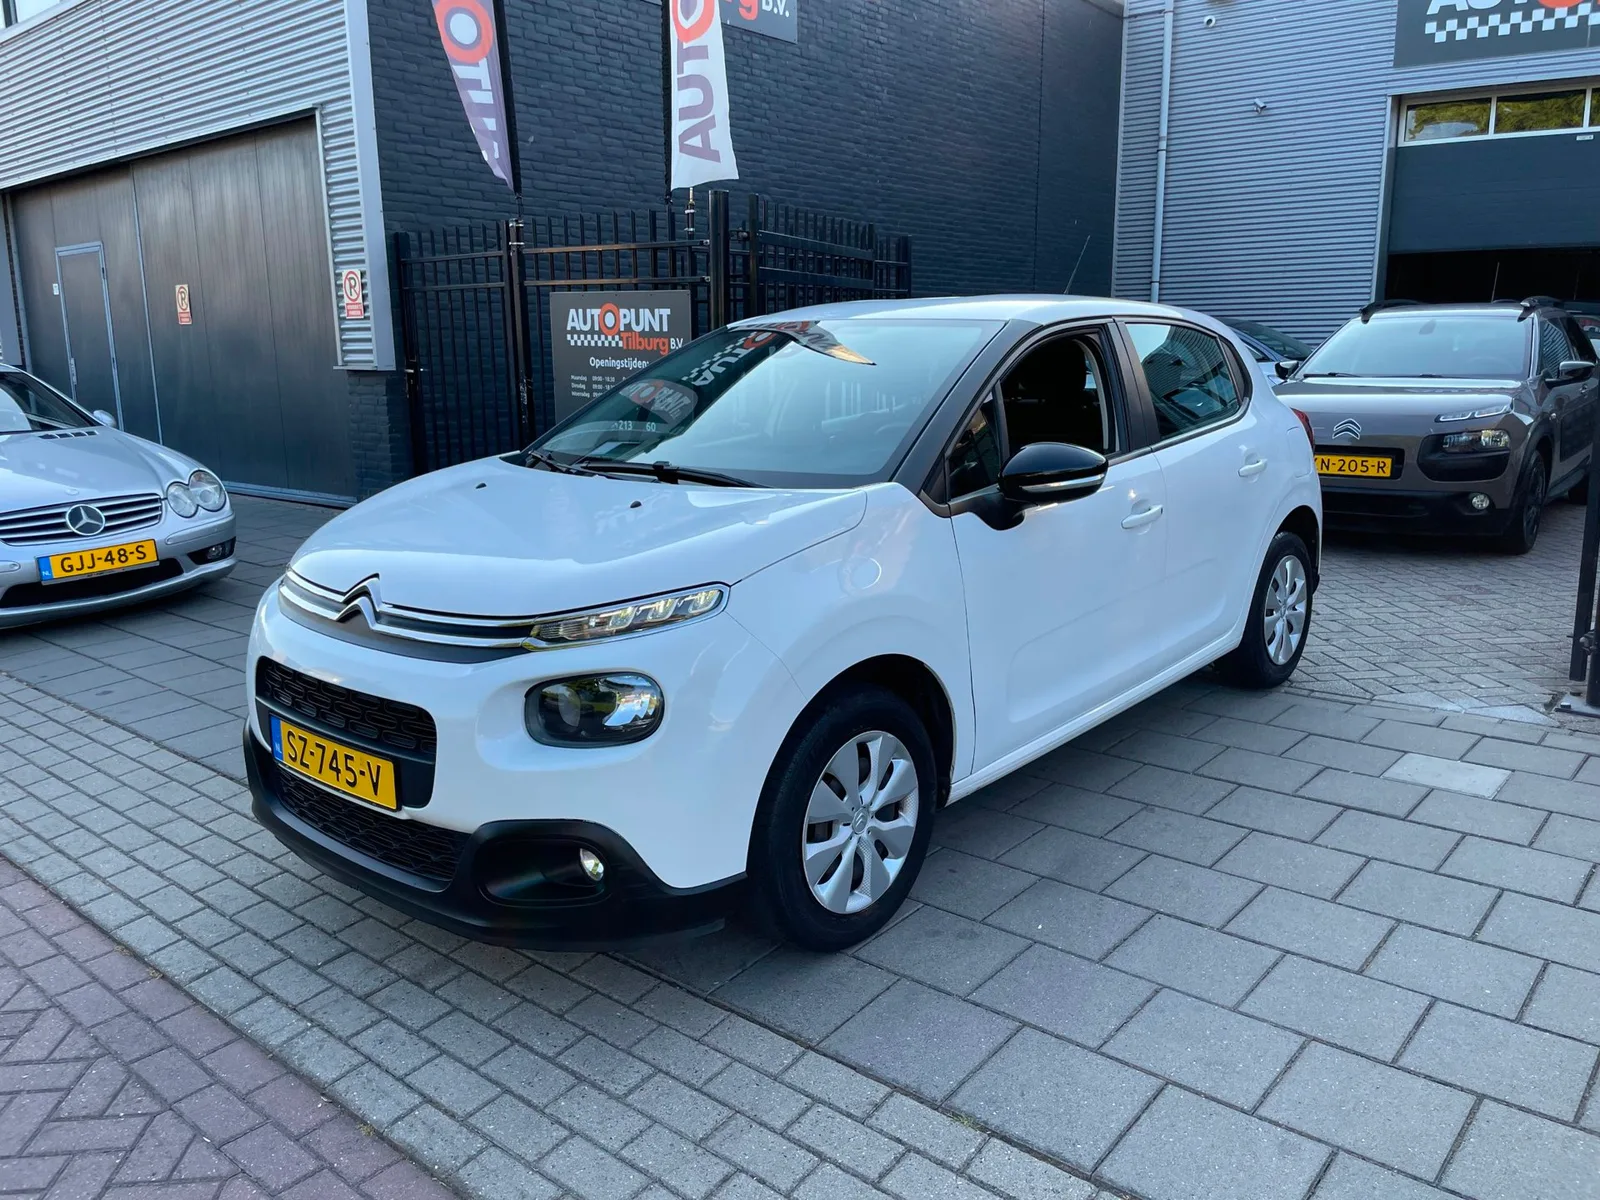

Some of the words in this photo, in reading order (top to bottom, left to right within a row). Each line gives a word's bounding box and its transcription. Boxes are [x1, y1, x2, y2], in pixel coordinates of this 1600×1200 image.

[566, 302, 671, 336] AUTOPUNT
[620, 331, 669, 355] Tilburg
[60, 545, 147, 573] GJJ-48-S
[287, 730, 381, 797] SZ-745-V
